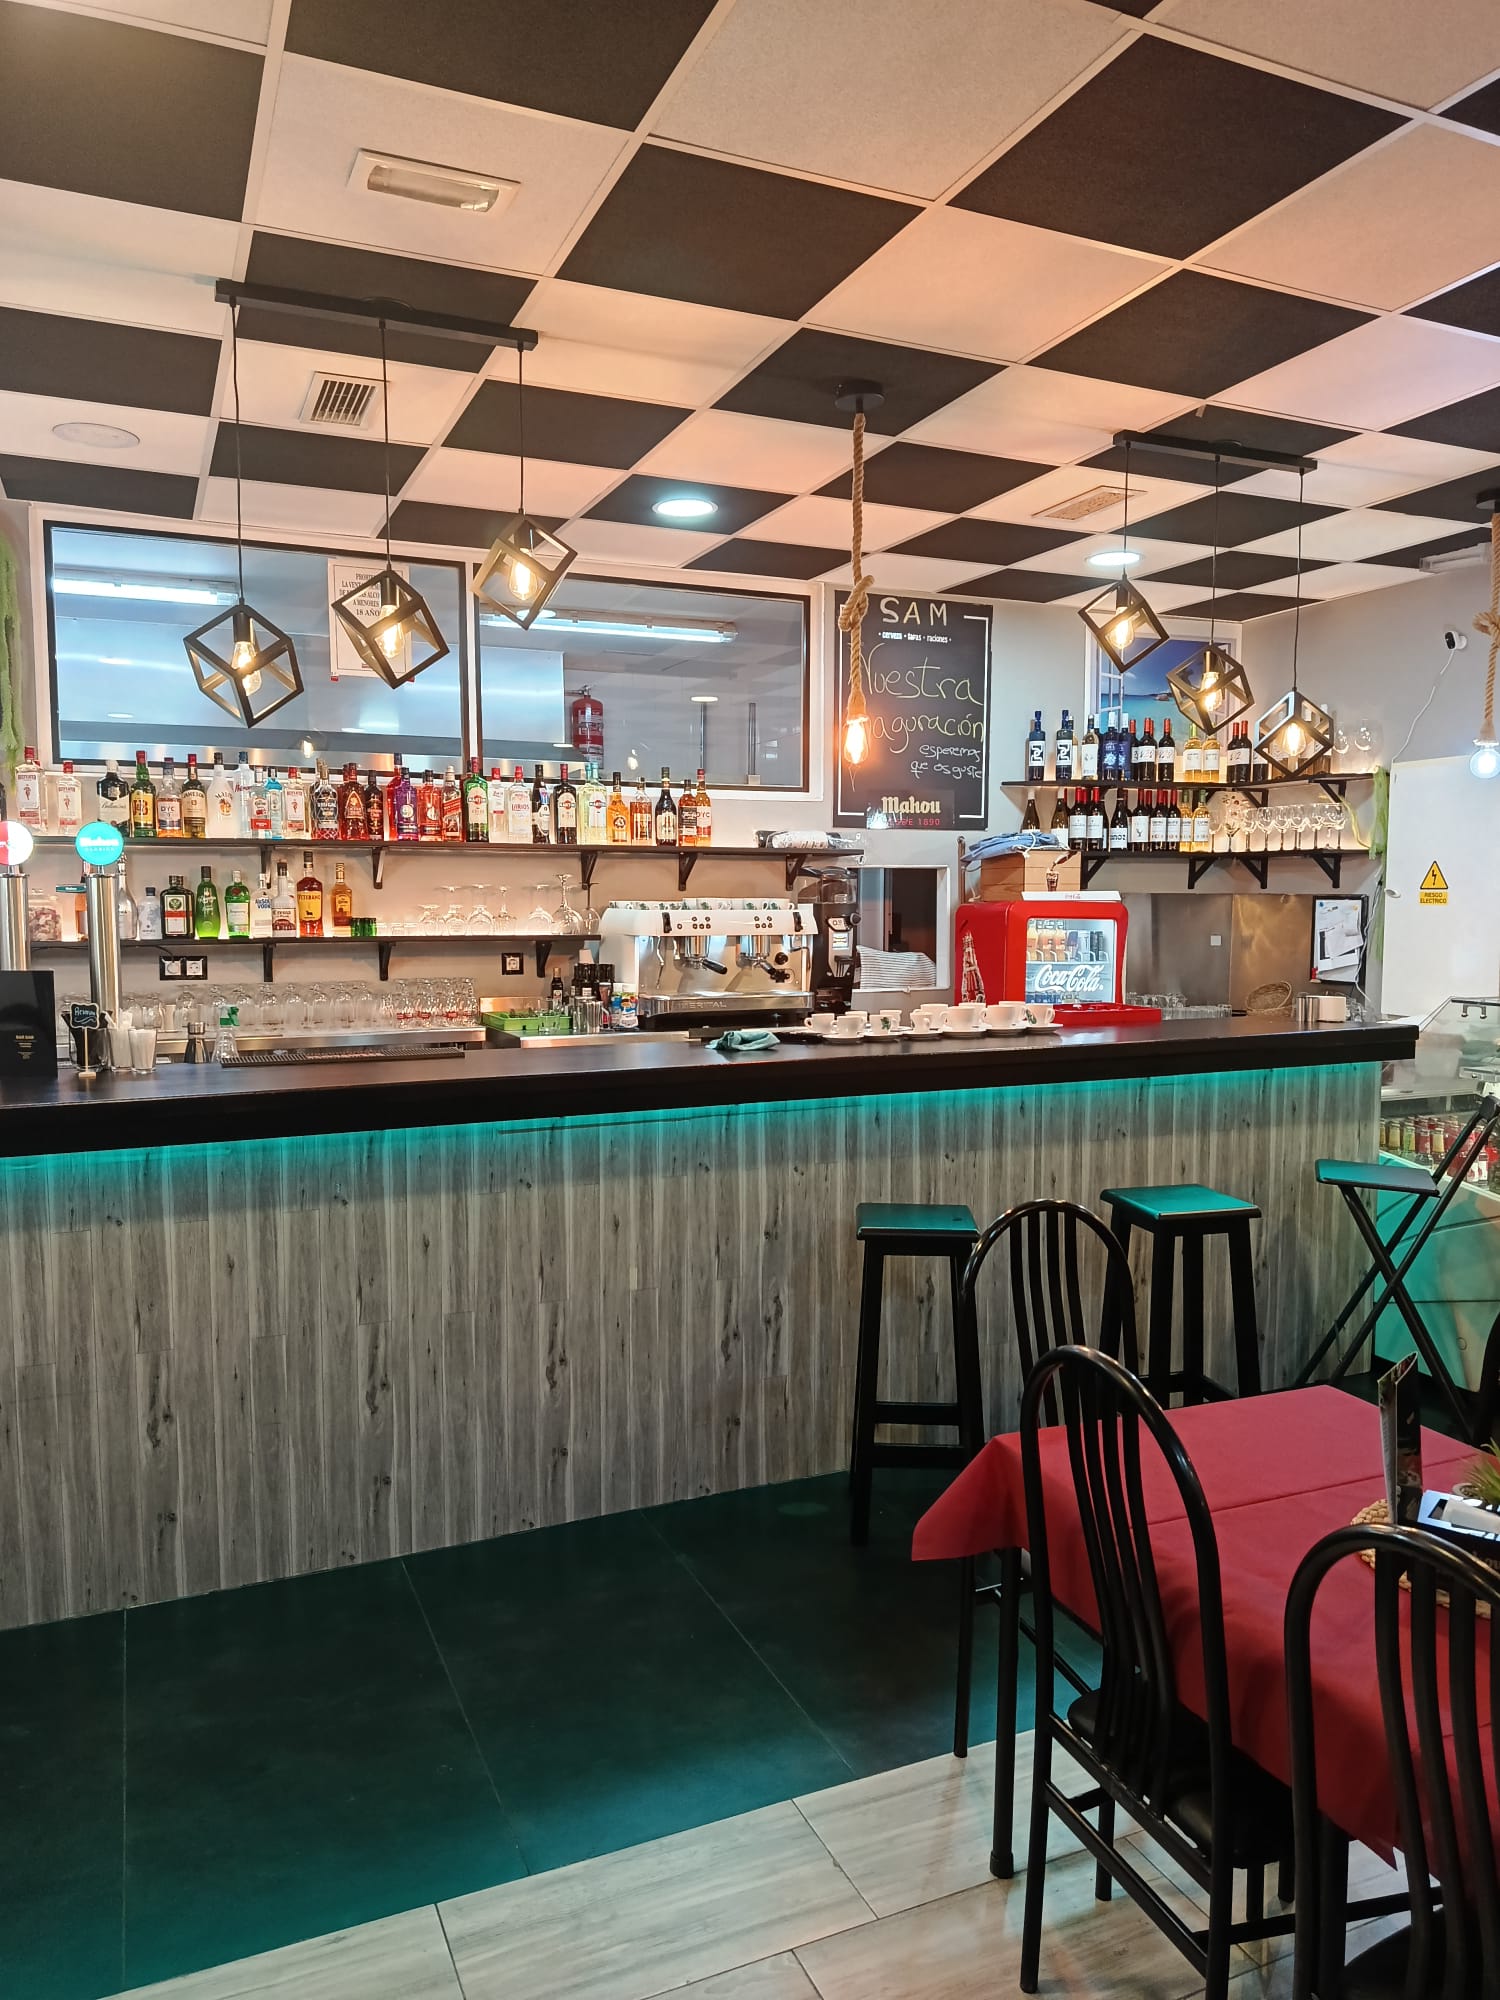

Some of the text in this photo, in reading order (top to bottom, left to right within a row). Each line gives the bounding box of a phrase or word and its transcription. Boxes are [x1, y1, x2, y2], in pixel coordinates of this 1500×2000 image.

[880, 596, 947, 626] SAM
[881, 796, 941, 814] Mahou
[1034, 964, 1105, 992] Coca-Cola
